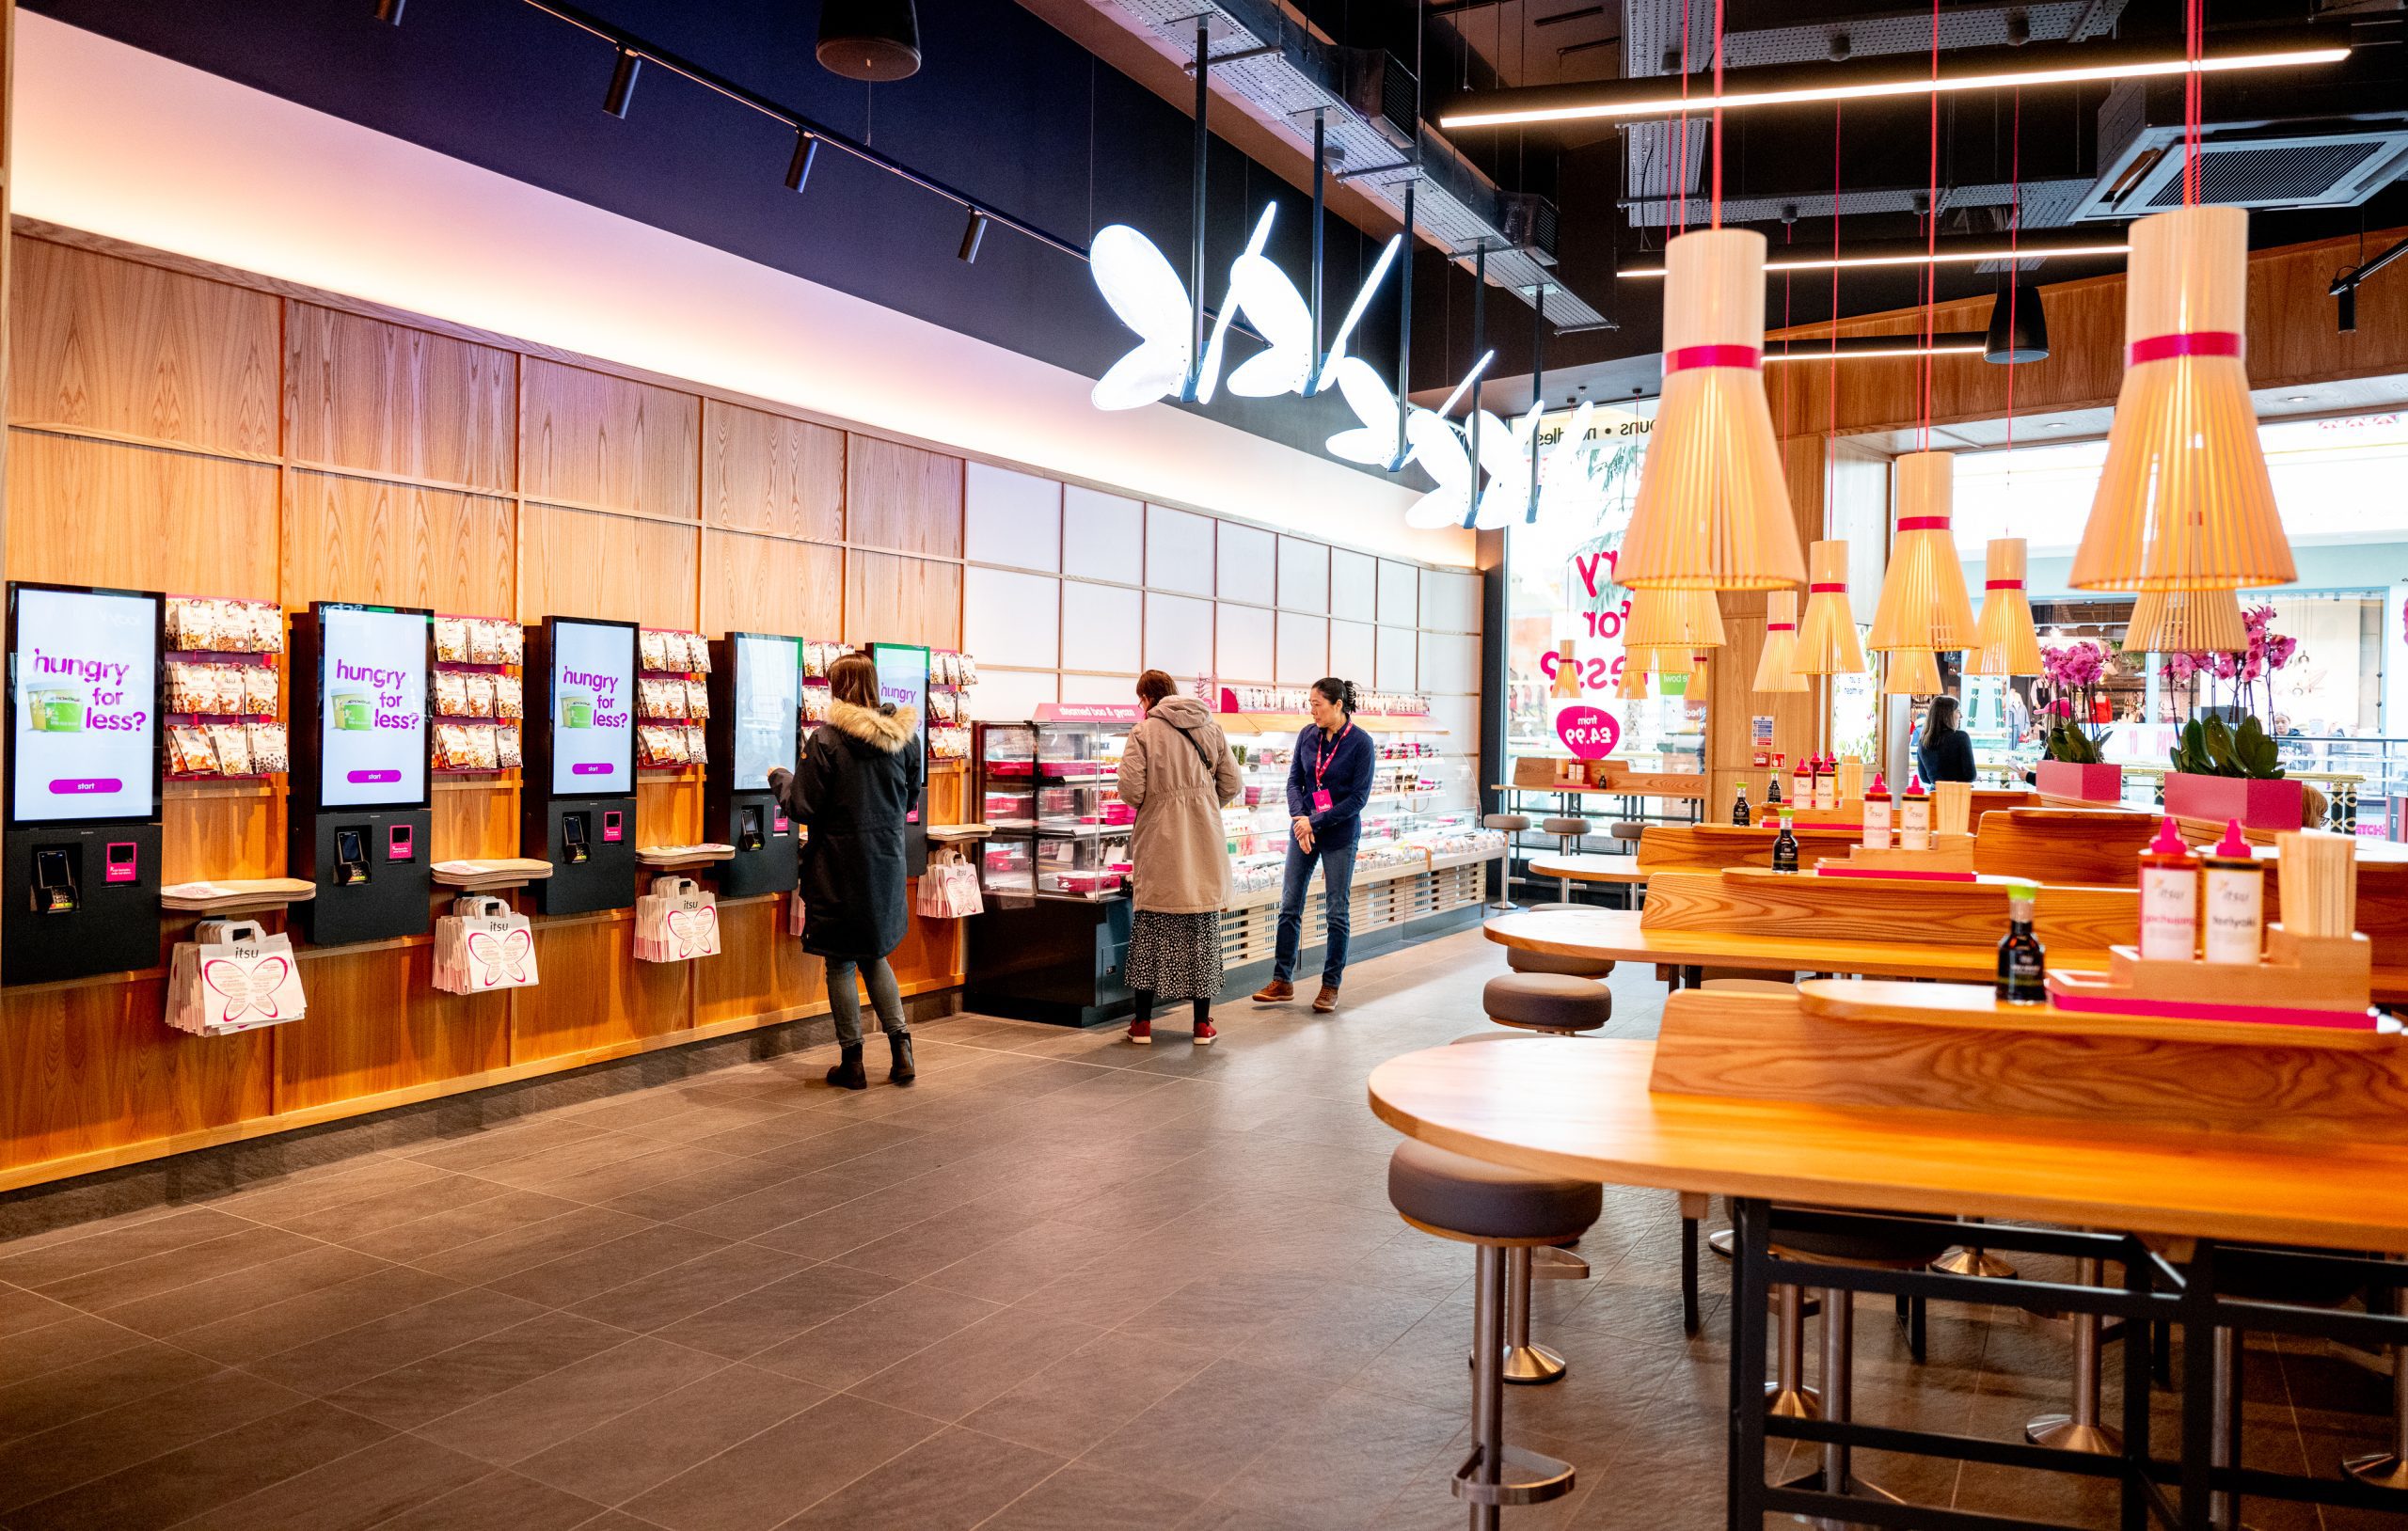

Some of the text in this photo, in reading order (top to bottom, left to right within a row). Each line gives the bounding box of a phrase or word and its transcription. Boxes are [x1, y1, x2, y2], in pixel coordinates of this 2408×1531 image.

[33, 648, 130, 687] hungry
[336, 658, 406, 690] hungry
[562, 665, 619, 694] hungry
[92, 687, 124, 706] for
[379, 692, 403, 708] for
[596, 695, 615, 709] for
[880, 682, 916, 703] hungry
[86, 706, 147, 732] less?
[374, 708, 420, 730] less?
[593, 709, 628, 729] less?
[956, 868, 967, 876] itsu
[683, 900, 699, 910] itsu
[489, 921, 509, 932] itsu
[234, 947, 260, 959] itsu
